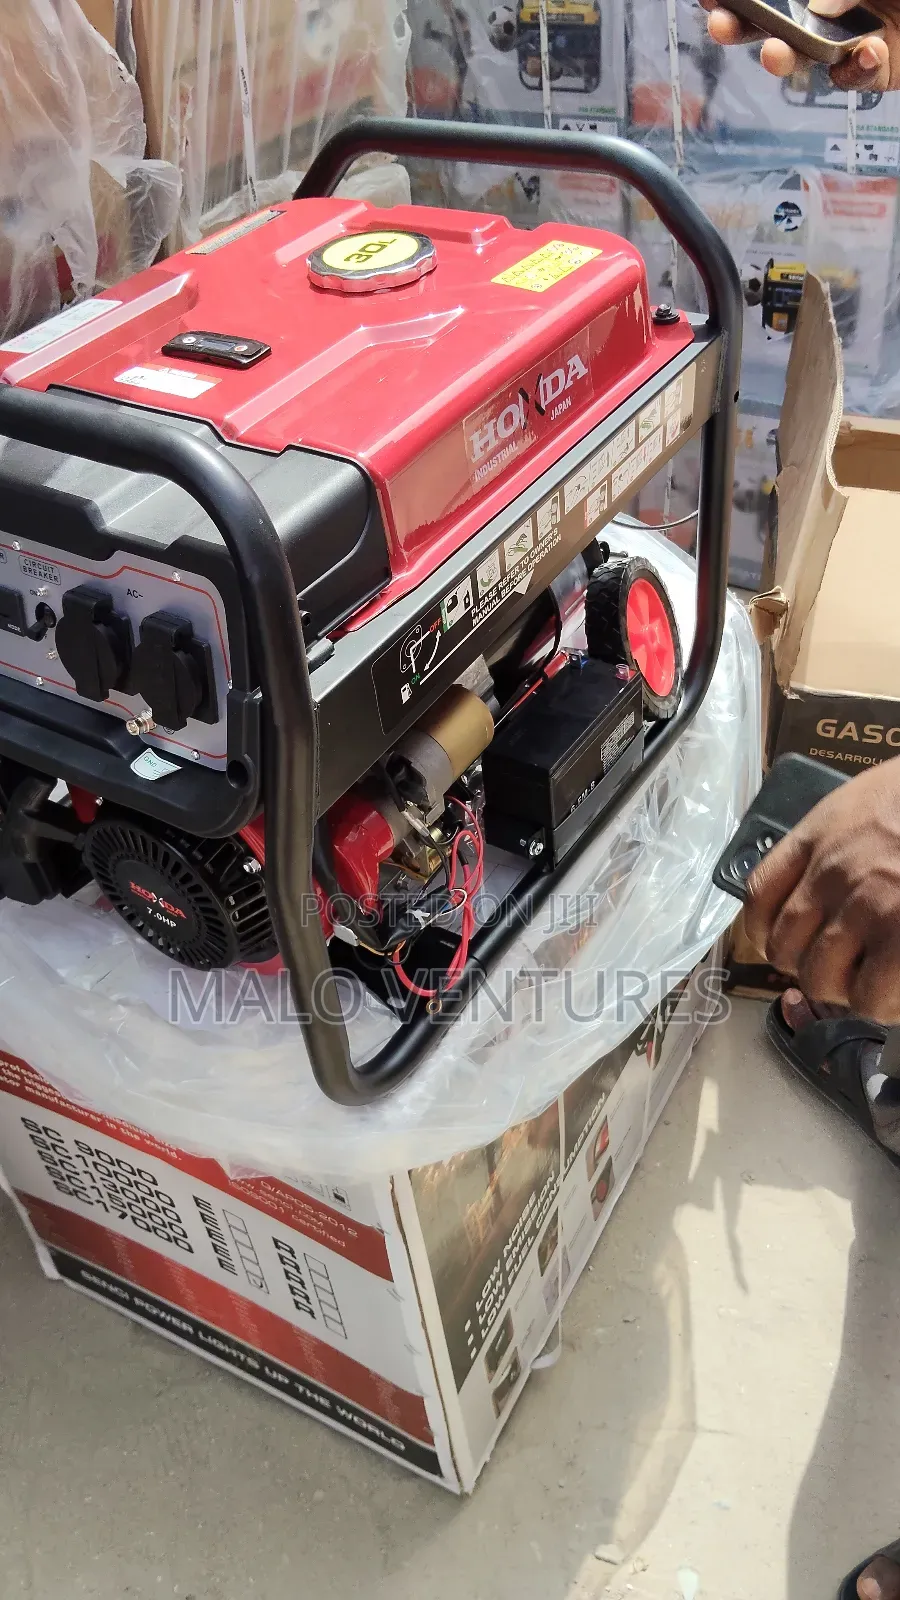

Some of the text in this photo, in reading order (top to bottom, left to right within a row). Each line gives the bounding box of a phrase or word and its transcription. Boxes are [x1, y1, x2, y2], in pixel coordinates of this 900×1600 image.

[344, 238, 397, 264] 30L
[550, 396, 572, 421] JAPAN
[473, 441, 518, 483] INDUSTRIAL
[23, 565, 59, 583] BREAKER
[24, 559, 54, 574] CIRCUIT
[471, 585, 498, 617] PLEASE
[498, 564, 520, 590] REFER
[520, 556, 529, 568] TO
[530, 528, 558, 557] OWNER'S
[472, 534, 562, 627] MANUAL BEFORE OPERATION
[429, 618, 442, 633] OFF
[410, 673, 421, 686] ON
[143, 755, 157, 768] GND
[25, 1085, 102, 1123] manufacturer
[106, 1120, 117, 1130] in
[120, 1127, 141, 1140] the
[20, 1117, 64, 1144] SC
[74, 1139, 158, 1187] 9000
[193, 1195, 215, 1215] E
[199, 1211, 221, 1230] E
[291, 1214, 346, 1248] certified
[205, 1226, 228, 1246] E
[479, 1273, 503, 1325] LOW
[505, 1170, 555, 1271] EMISSION
[211, 1241, 233, 1261] E
[476, 1259, 501, 1312] LOW
[503, 1191, 537, 1257] NOISE
[217, 1257, 238, 1276] E
[481, 1287, 506, 1339] LOW
[507, 1236, 534, 1285] FUEL
[133, 1297, 194, 1334] POWER
[198, 1330, 260, 1369] LIGHTS
[264, 1366, 290, 1384] UP
[294, 1382, 331, 1409] THE
[335, 1405, 406, 1451] WORLD
